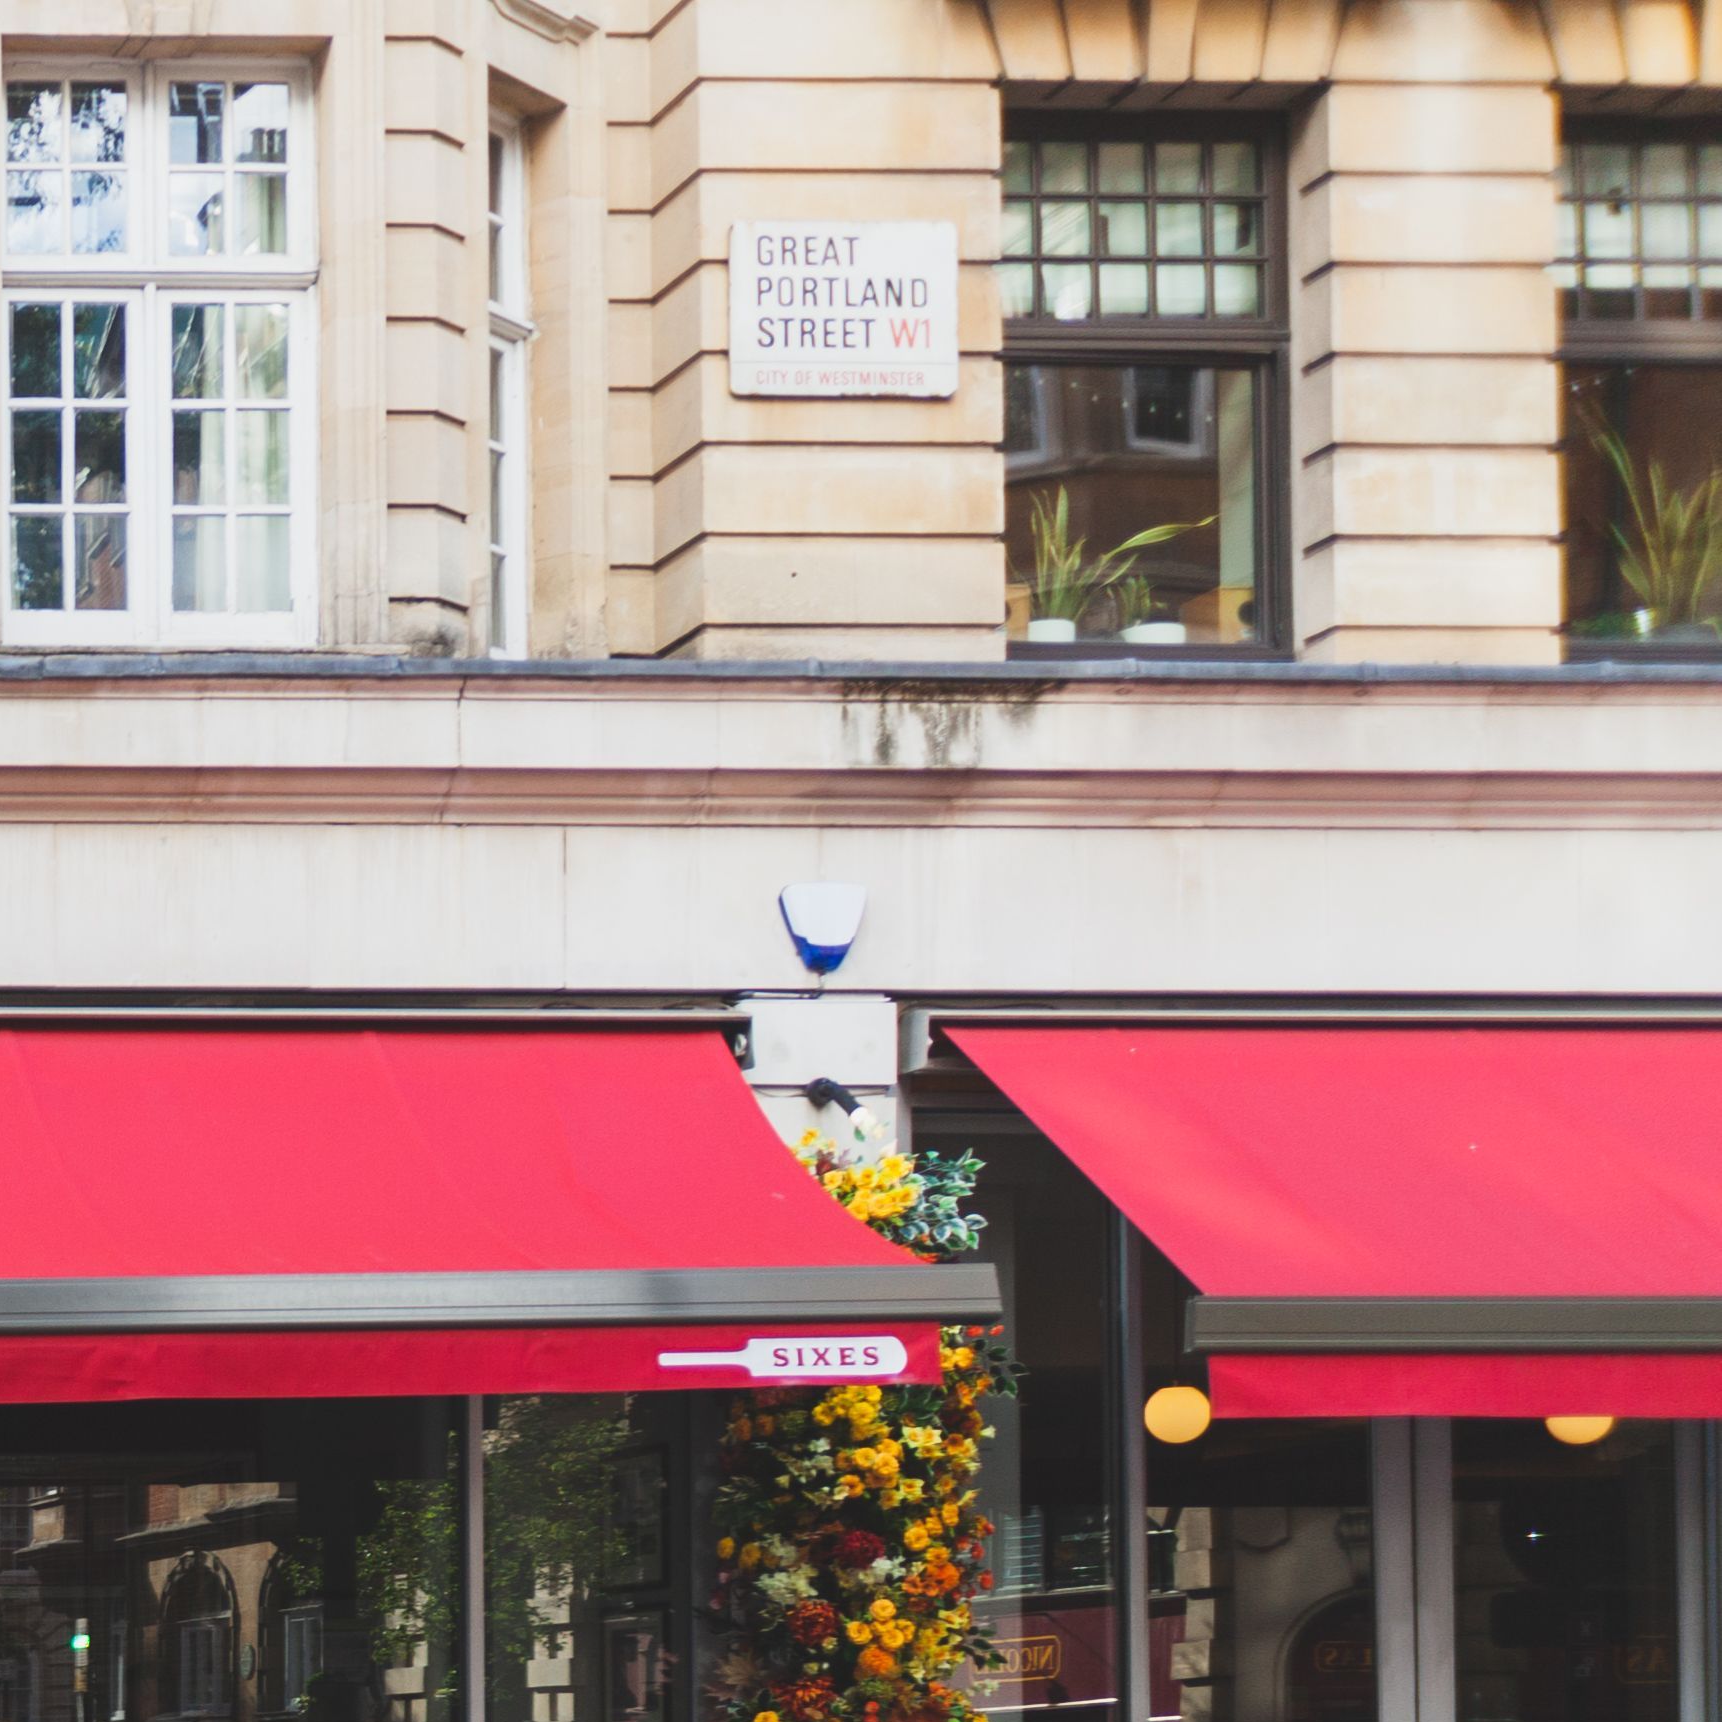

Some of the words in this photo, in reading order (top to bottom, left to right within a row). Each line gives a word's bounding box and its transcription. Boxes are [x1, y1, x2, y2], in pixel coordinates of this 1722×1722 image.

[757, 235, 860, 266] GREAT
[757, 277, 928, 308] PORTLAND
[757, 317, 876, 348] STREET
[889, 318, 931, 348] W1
[756, 370, 788, 386] CITY
[795, 370, 813, 386] OF
[819, 370, 924, 387] WESTMINSTER
[773, 1346, 880, 1367] SIXES
